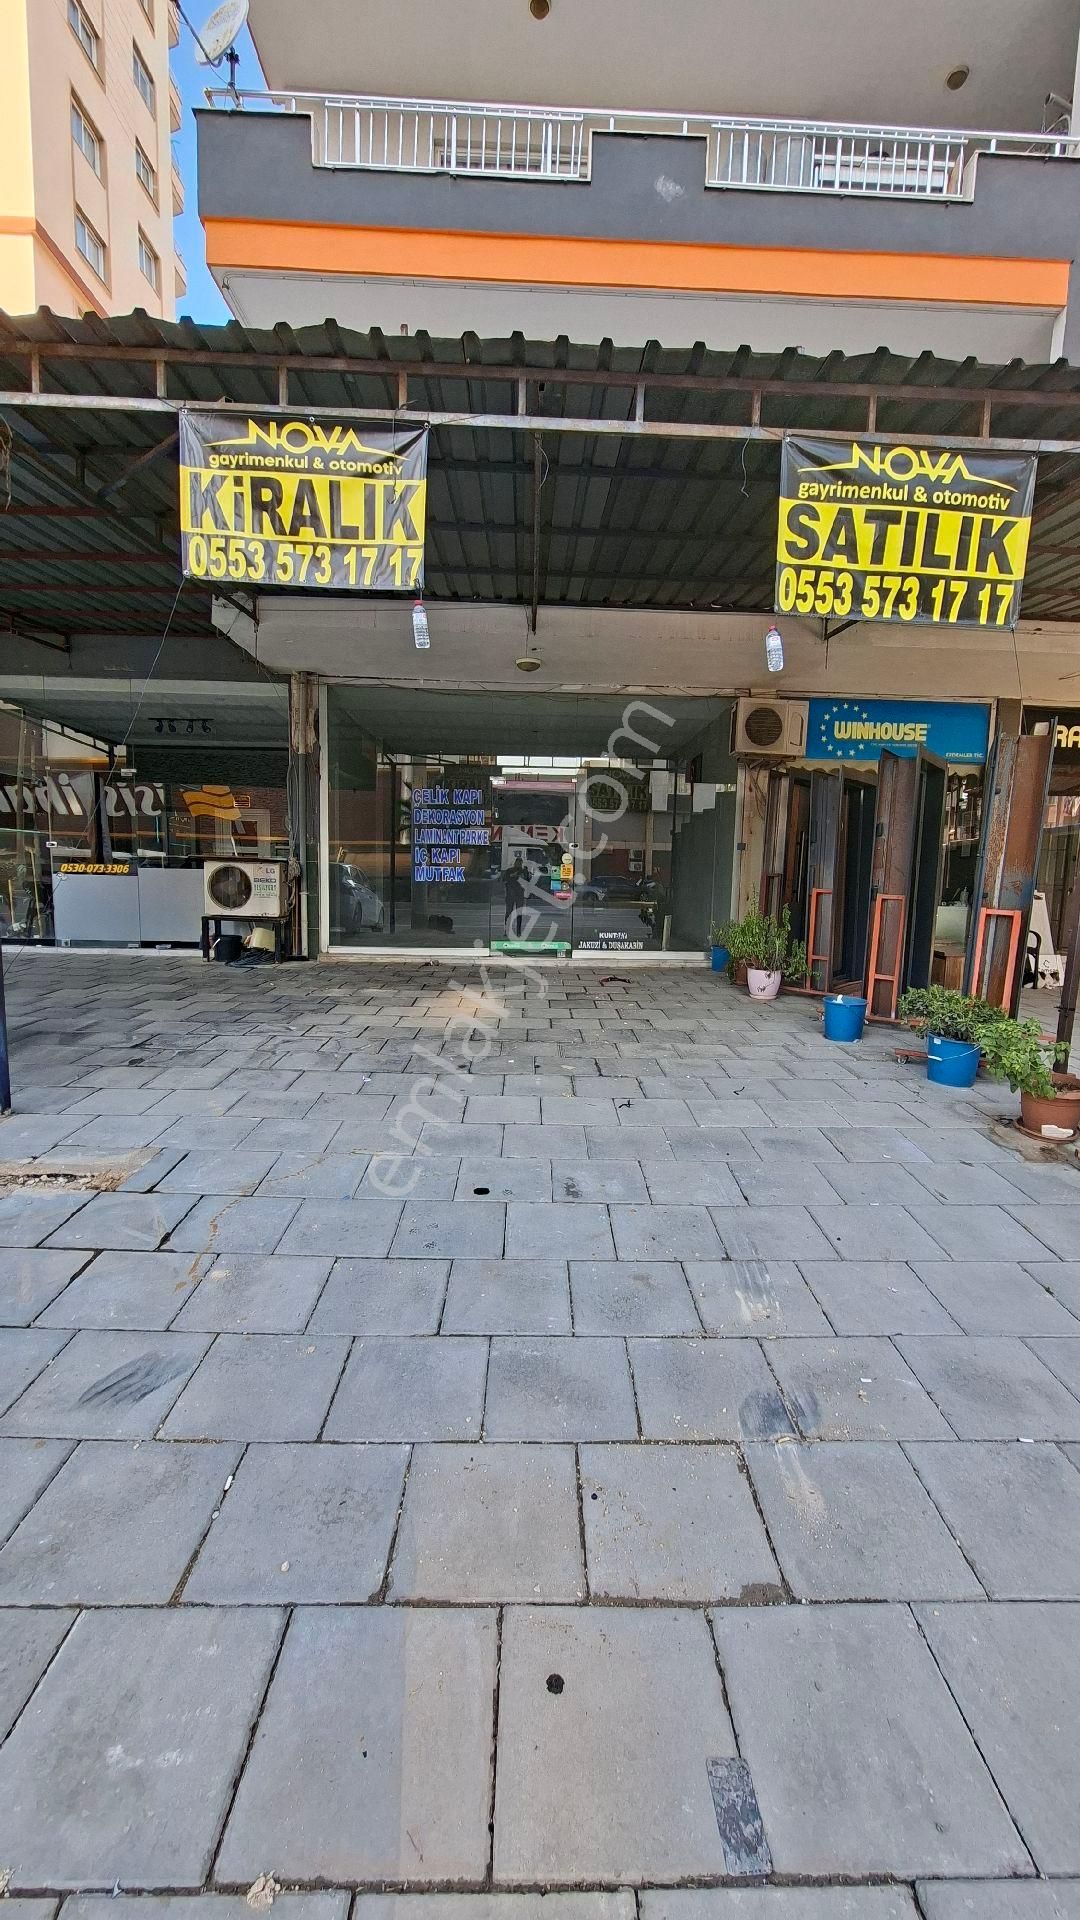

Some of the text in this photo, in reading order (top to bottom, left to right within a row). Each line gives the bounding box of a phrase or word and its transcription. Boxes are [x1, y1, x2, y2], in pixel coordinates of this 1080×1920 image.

[220, 418, 388, 457] NOVA
[208, 451, 403, 476] gayrimenkul & otomotiv
[818, 442, 994, 487] NOVA
[797, 480, 1010, 511] gayrimenkul & otomotiv
[784, 503, 1019, 576] SATILIK
[188, 536, 423, 586] 0553 573 17 17
[778, 566, 1015, 625] 0553 573 17 17
[833, 720, 928, 742] WINHOUSE
[412, 784, 482, 807] ÇELİK KAPI
[413, 808, 485, 826] DEKORASYON
[431, 847, 461, 864] KAPI
[60, 863, 130, 874] 0530-073-3306
[414, 866, 466, 882] MUTFAK
